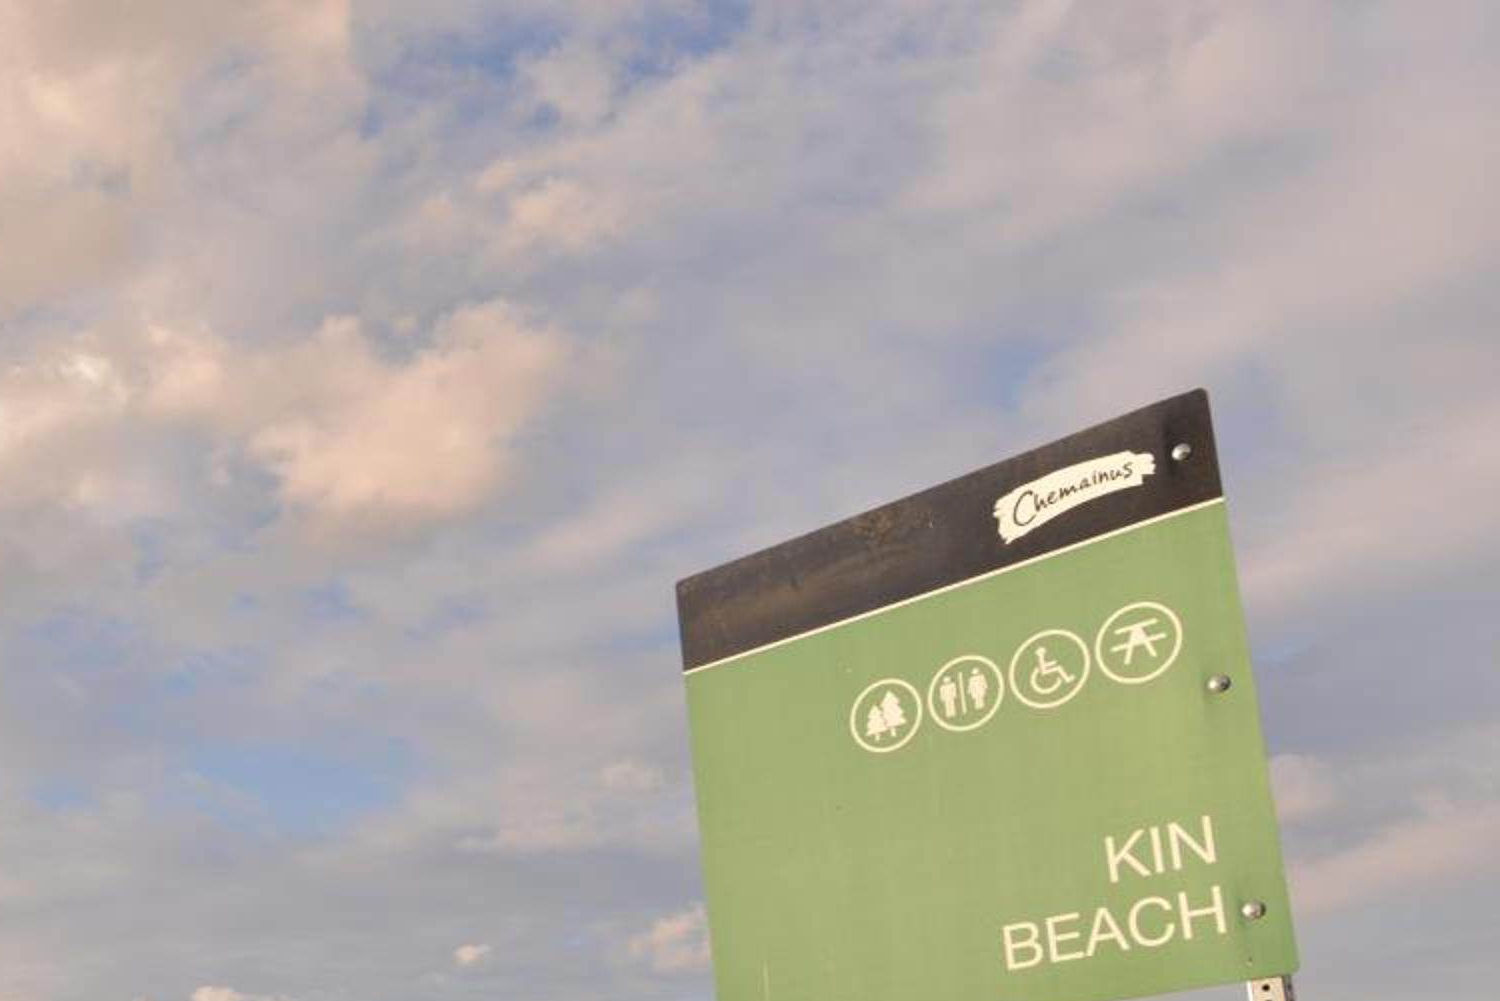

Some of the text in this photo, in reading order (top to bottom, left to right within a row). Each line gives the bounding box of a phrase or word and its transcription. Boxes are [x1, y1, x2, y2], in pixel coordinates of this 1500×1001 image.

[1013, 460, 1134, 527] Chemainus
[1104, 815, 1217, 883] KIN
[1003, 885, 1227, 971] BEACH
